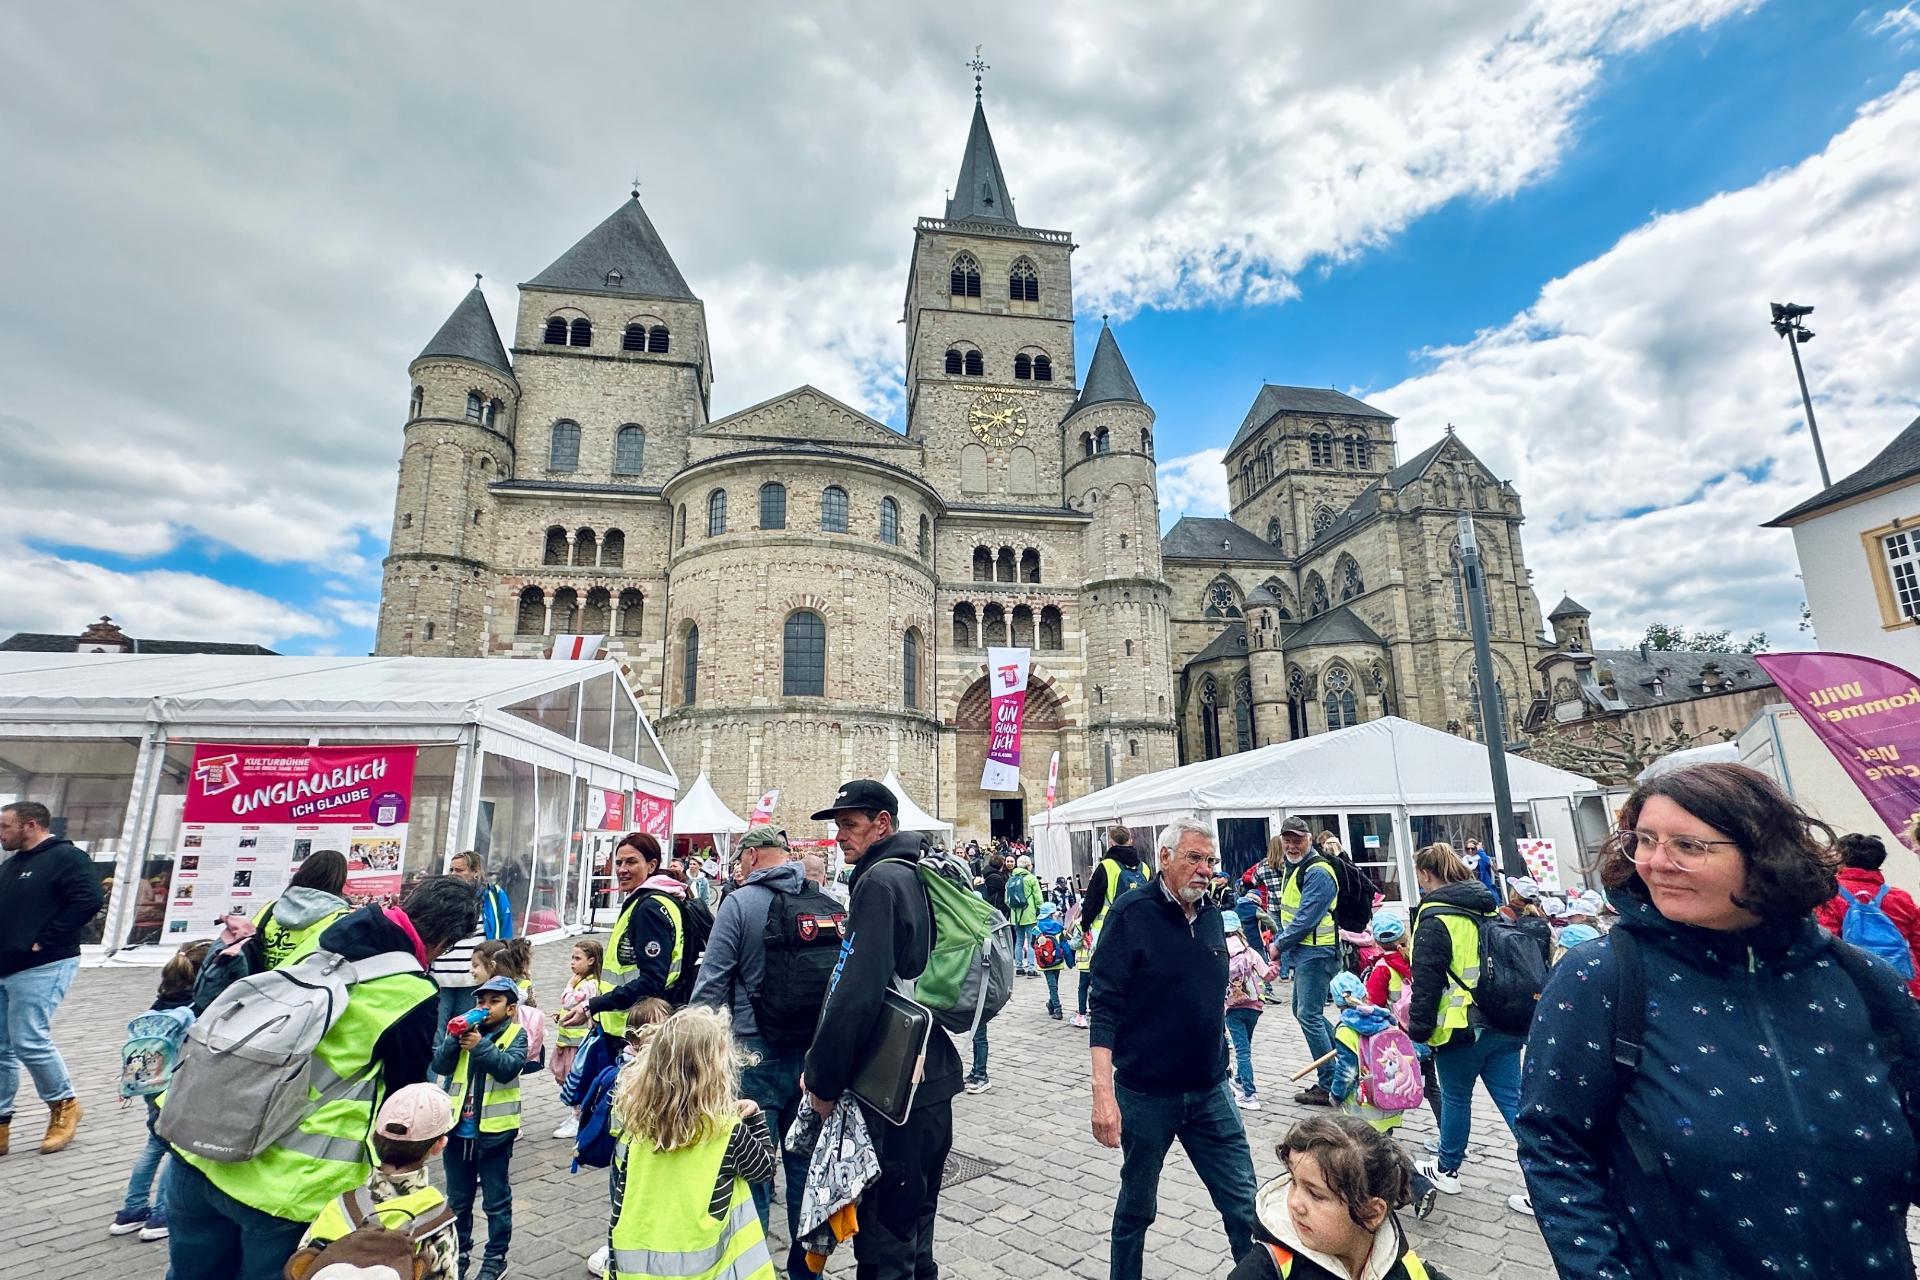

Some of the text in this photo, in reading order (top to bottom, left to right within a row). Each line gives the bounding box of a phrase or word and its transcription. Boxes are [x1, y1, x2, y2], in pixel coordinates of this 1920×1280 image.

[998, 704, 1018, 722] UN
[995, 722, 1017, 734] GLAUB
[244, 757, 310, 767] KULTURBÜHNE
[292, 805, 314, 818] ICH
[317, 788, 370, 811] GLAUBE
